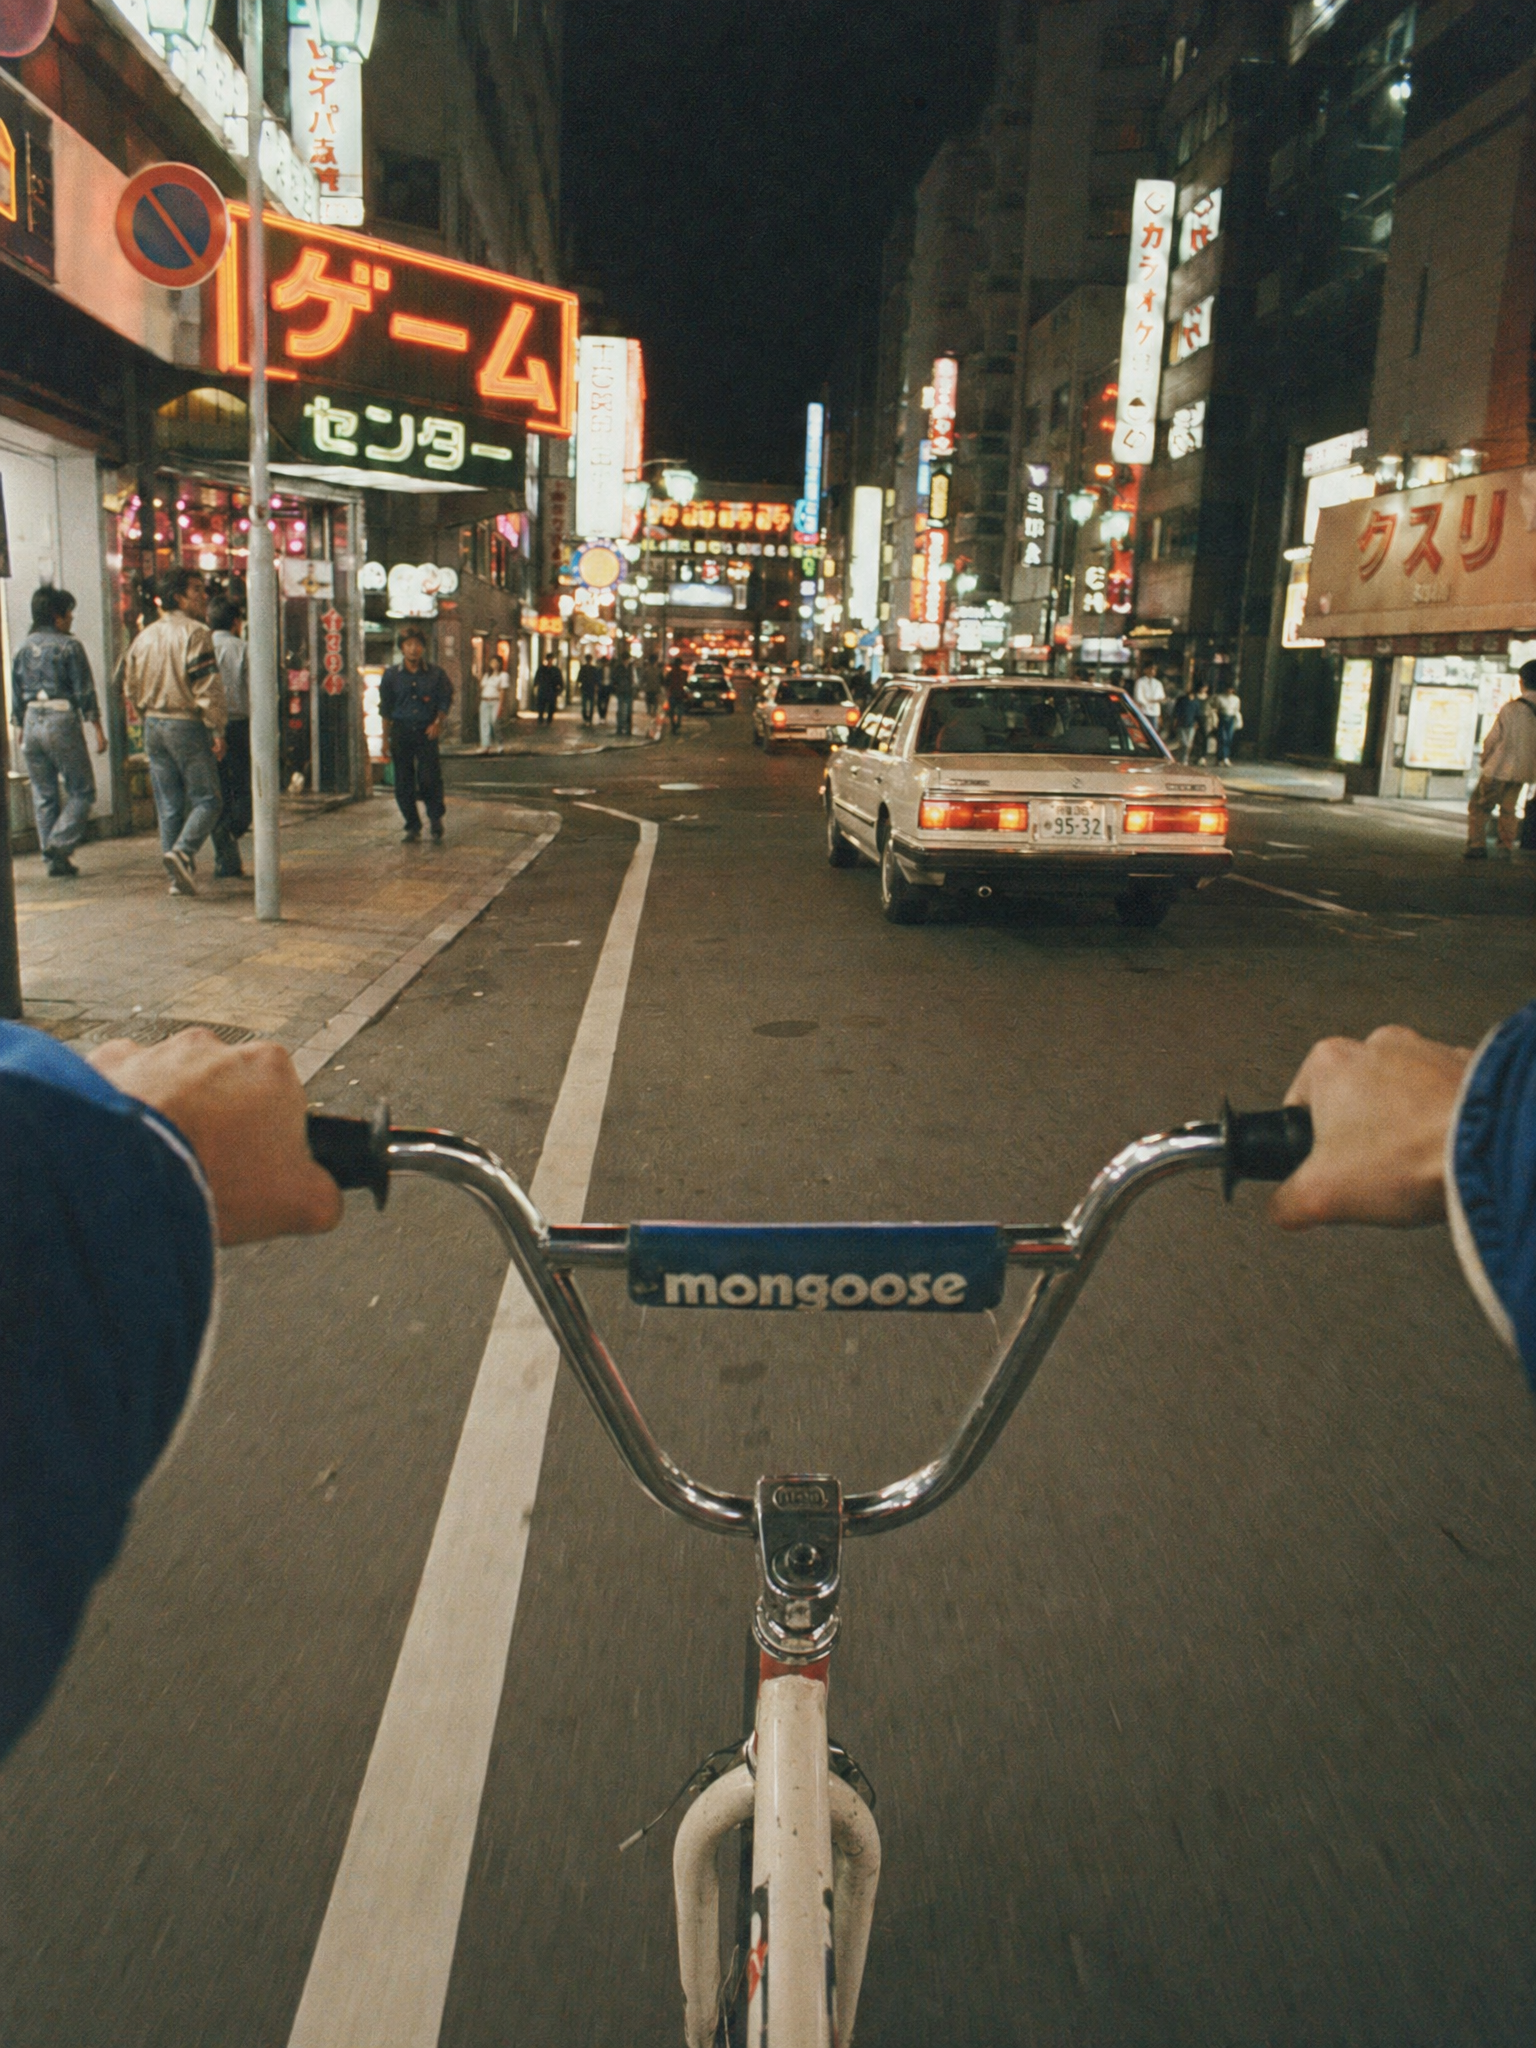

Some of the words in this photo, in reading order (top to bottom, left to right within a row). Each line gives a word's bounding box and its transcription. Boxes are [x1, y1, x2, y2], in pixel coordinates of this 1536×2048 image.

[1136, 221, 1165, 346] カラオケ
[272, 247, 557, 412] ゲーム
[303, 396, 512, 471] センター
[1357, 488, 1508, 583] クスリ
[1054, 817, 1101, 835] 95-32
[664, 1271, 968, 1310] mongoose
